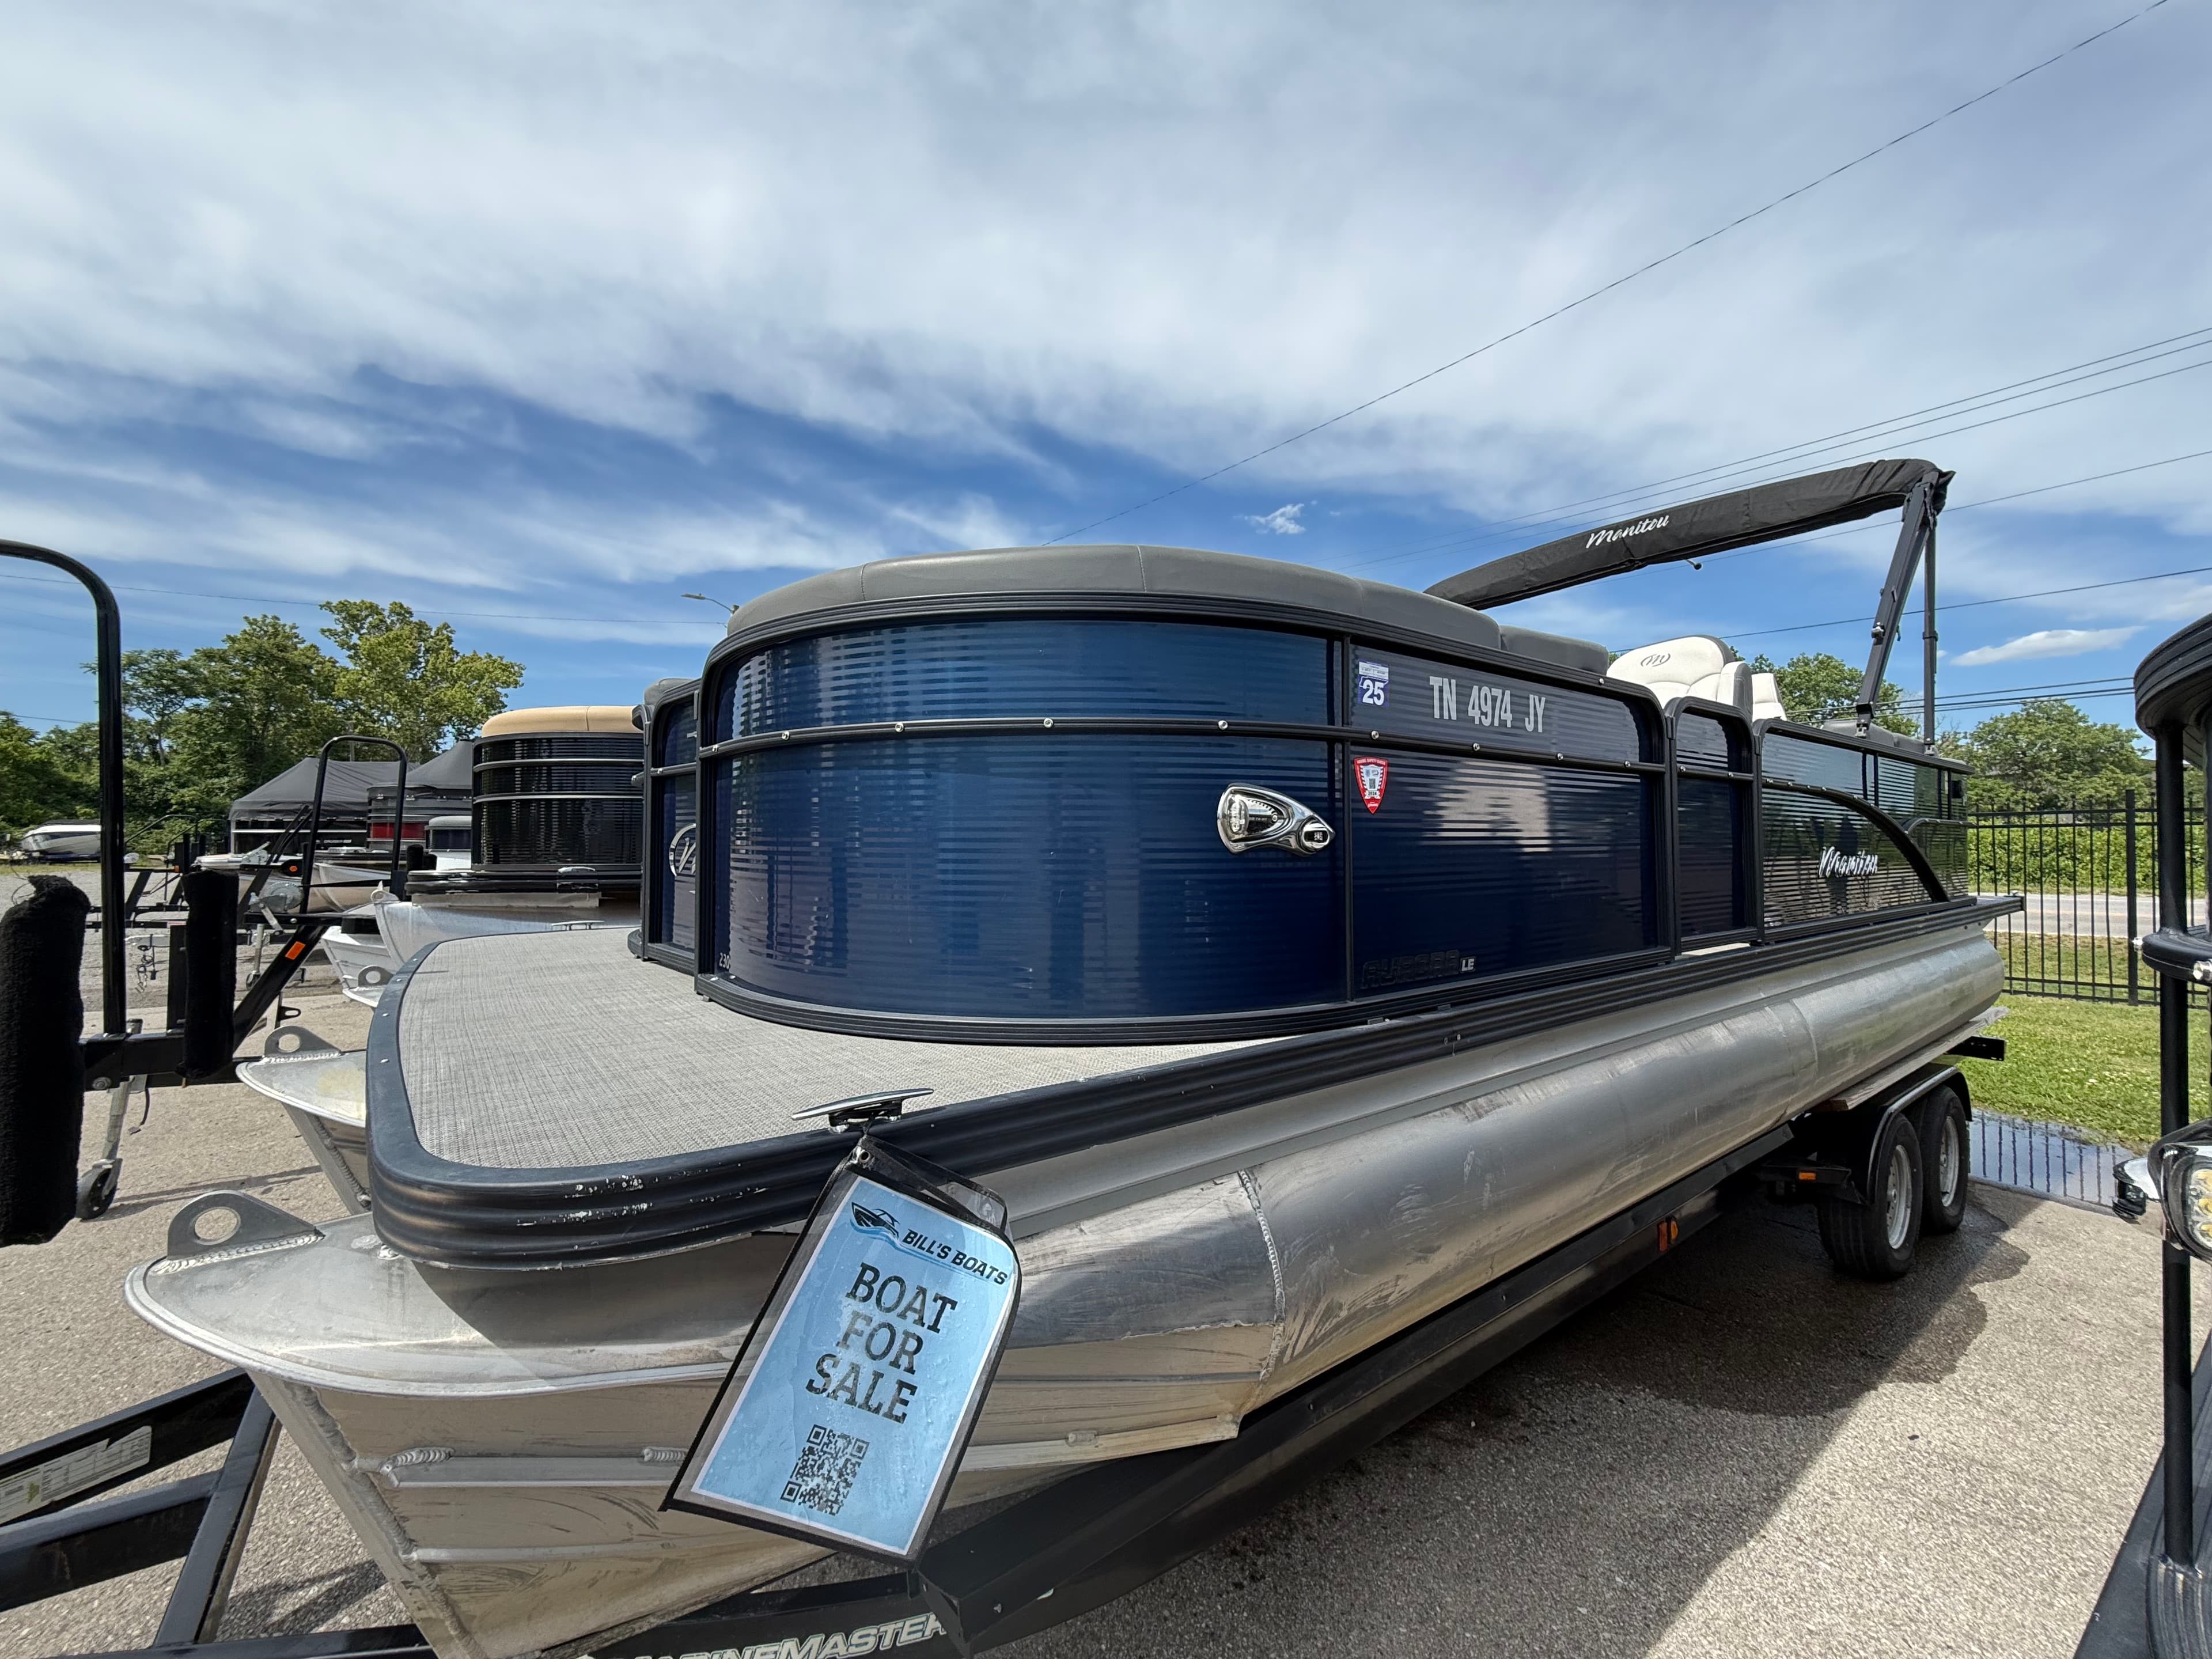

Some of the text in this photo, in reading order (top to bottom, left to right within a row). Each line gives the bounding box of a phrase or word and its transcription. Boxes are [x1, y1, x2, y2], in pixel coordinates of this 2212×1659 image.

[1586, 515, 1669, 548] Manitou
[1362, 679, 1385, 706] 25
[1429, 676, 1546, 733] TN 4974 JY
[719, 952, 730, 969] 230
[1461, 957, 1475, 972] LE
[902, 1228, 1008, 1286] BILL'S BOATS
[845, 1262, 958, 1334] BOAT
[835, 1310, 925, 1375] FOR
[805, 1354, 918, 1424] SALE
